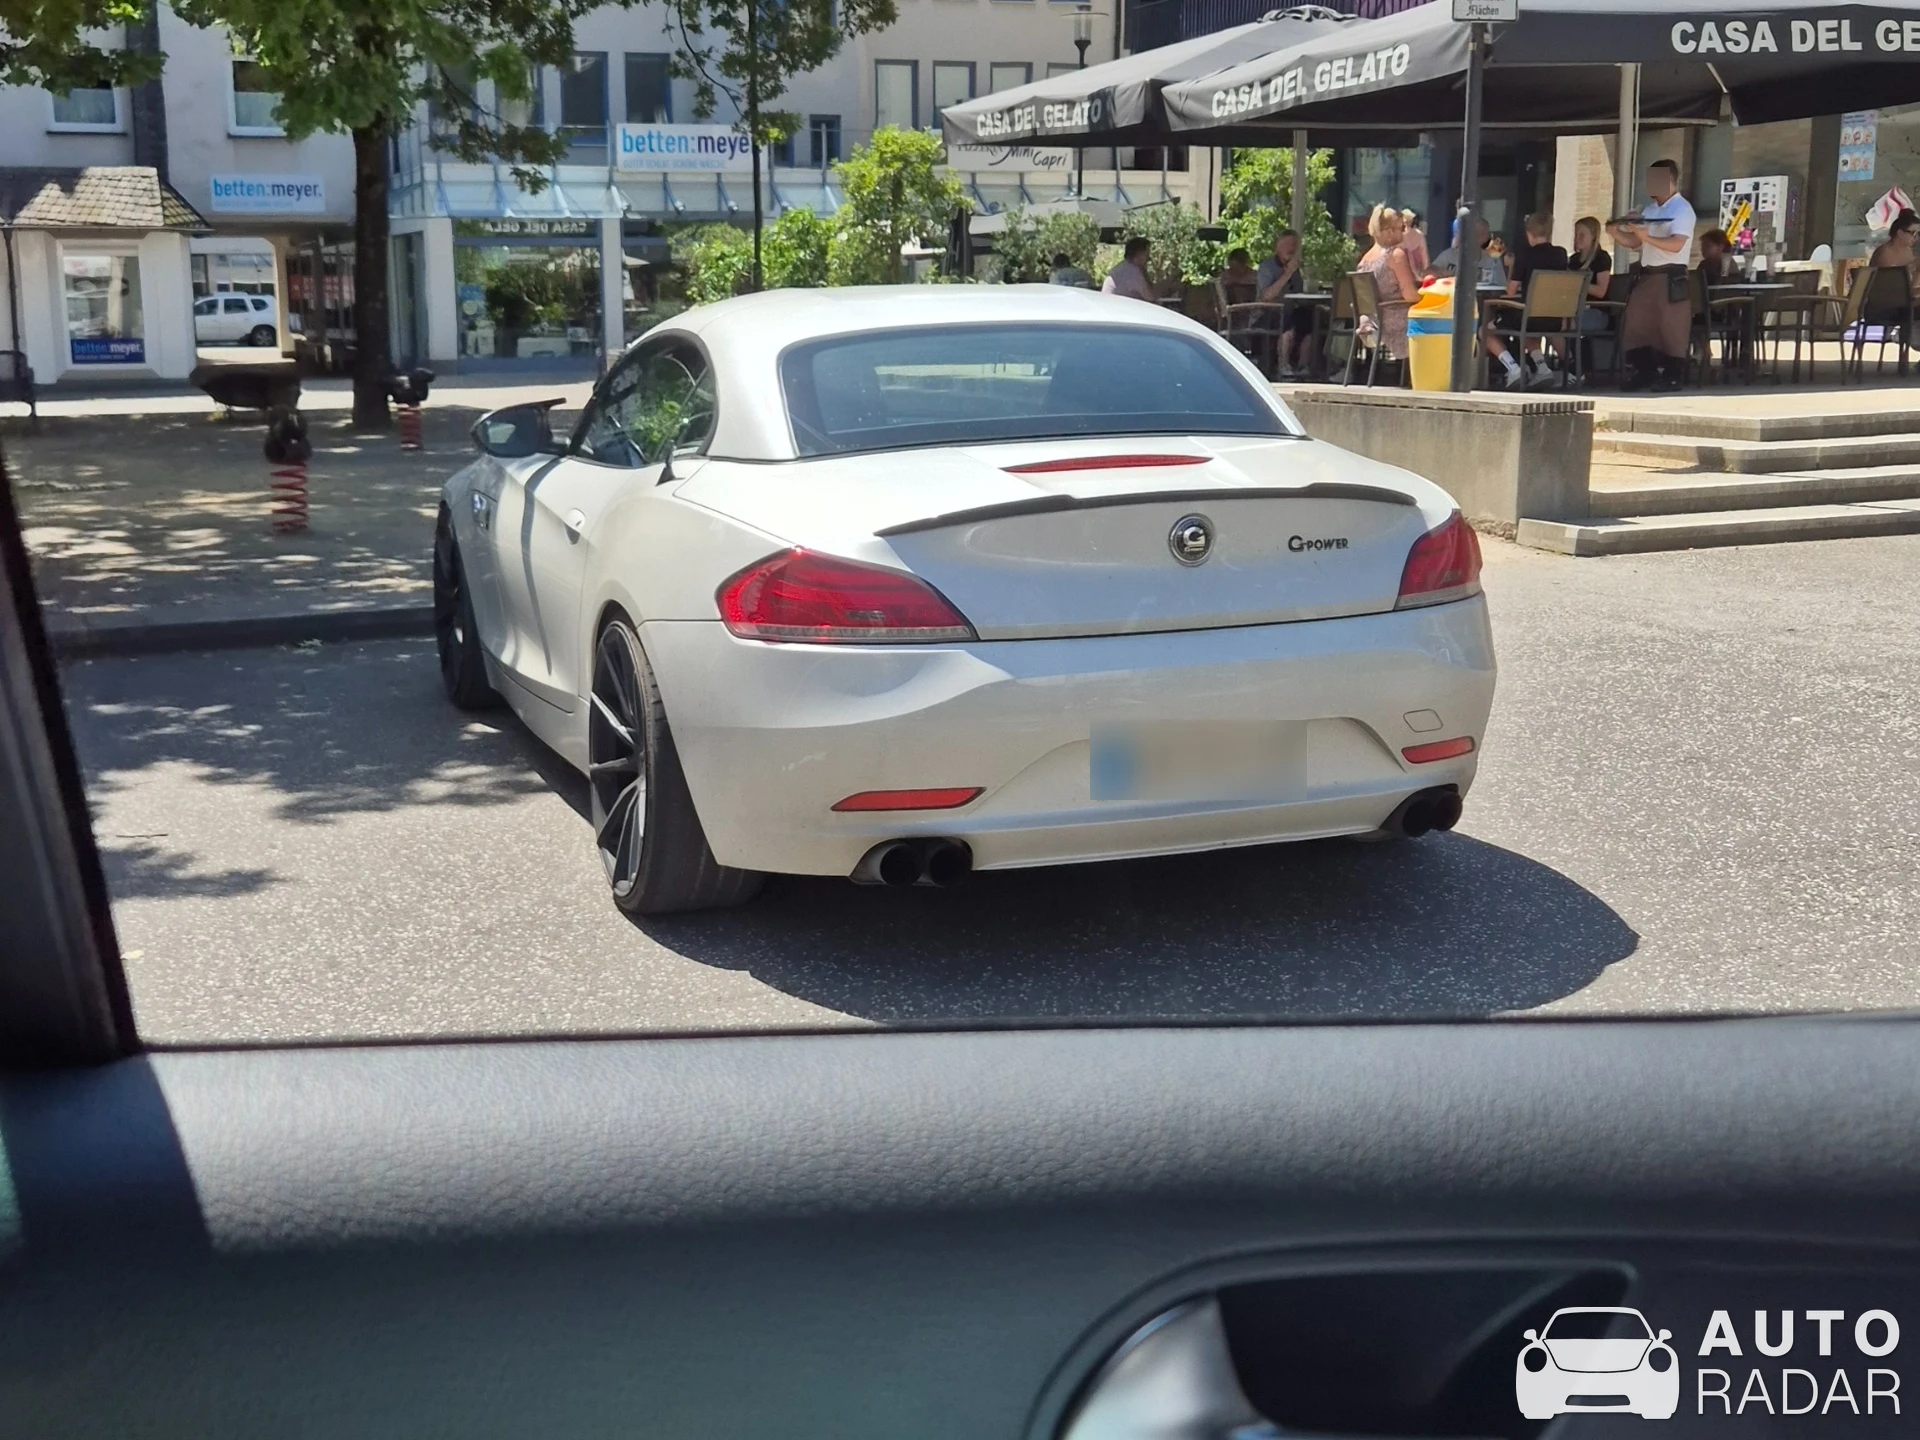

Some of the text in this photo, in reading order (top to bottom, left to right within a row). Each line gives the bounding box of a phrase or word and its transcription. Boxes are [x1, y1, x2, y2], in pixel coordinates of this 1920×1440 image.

[1671, 21, 1778, 53] CASA
[1790, 19, 1863, 52] DEL
[1211, 43, 1410, 118] CASA DEL GELATO
[976, 98, 1102, 136] CASA DEL GELATO
[621, 127, 750, 160] betten:meye
[1032, 151, 1068, 171] Capri
[213, 177, 322, 201] betten:meyer.
